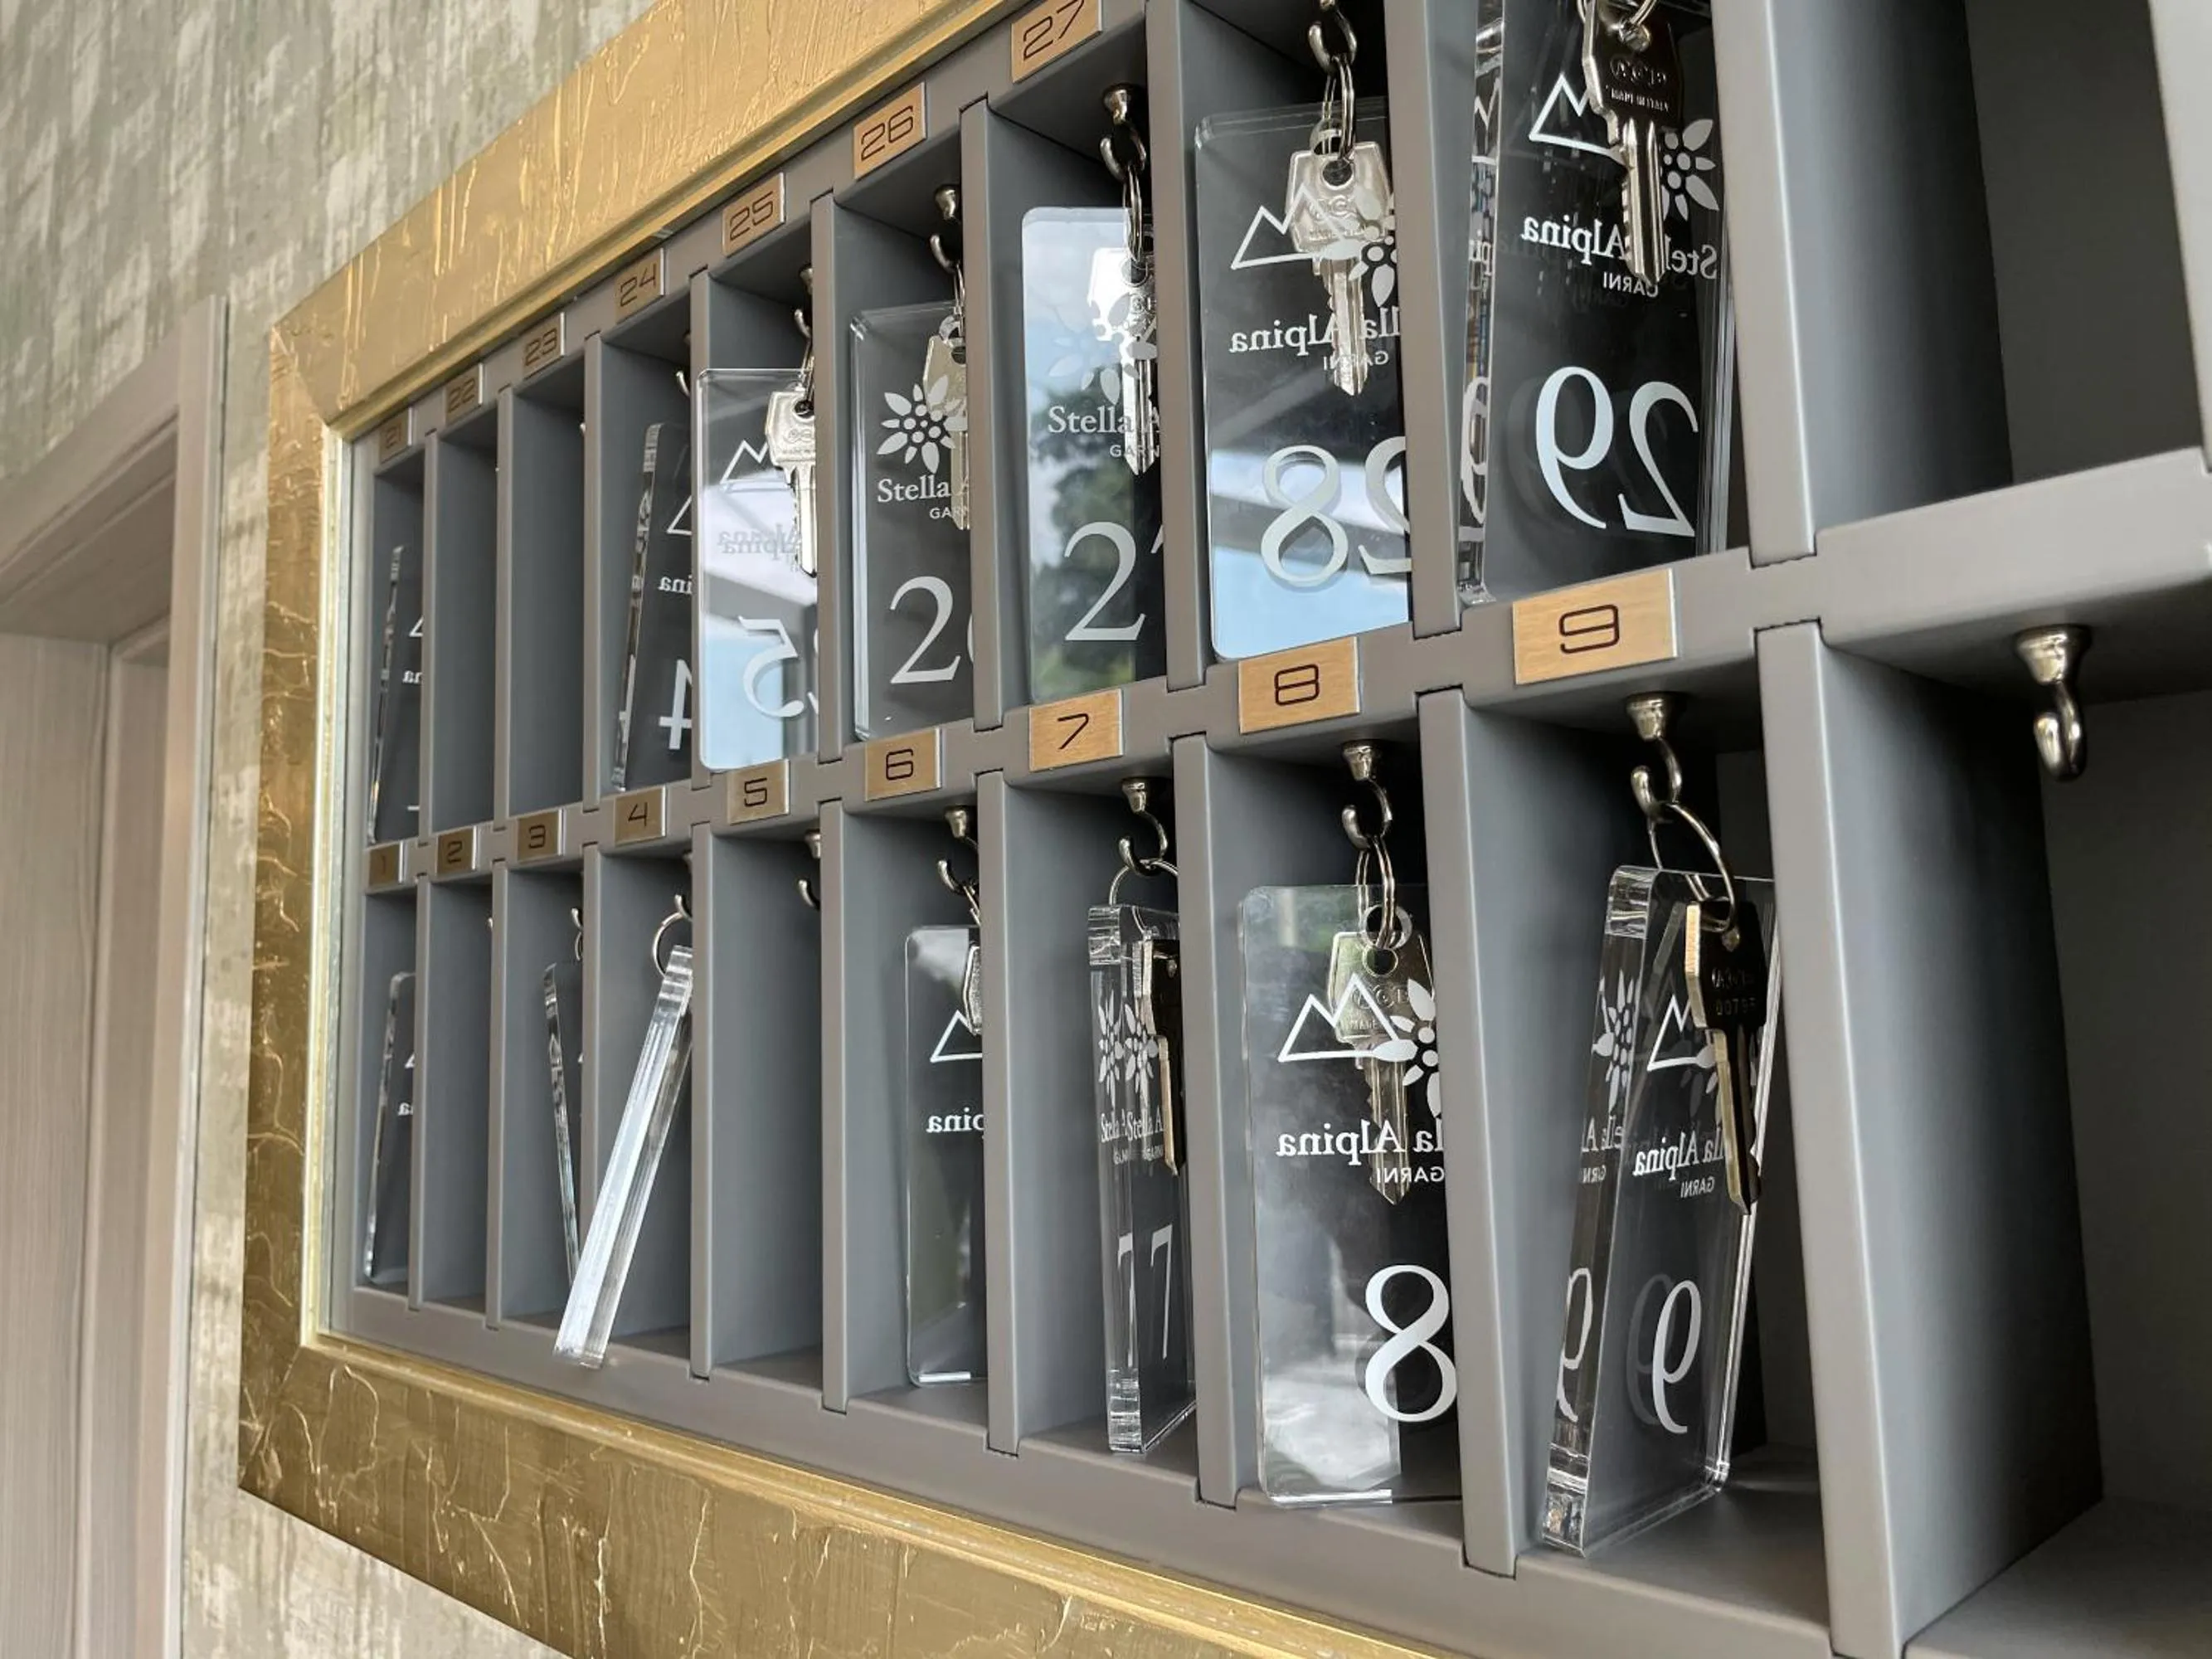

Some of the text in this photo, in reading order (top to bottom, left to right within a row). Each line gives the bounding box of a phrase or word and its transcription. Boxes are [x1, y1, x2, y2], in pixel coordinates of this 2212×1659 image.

[1022, 0, 1085, 61] 27
[860, 105, 914, 161] 26
[728, 190, 775, 241] 25
[620, 263, 657, 308] 24
[524, 327, 557, 367] 23
[448, 377, 476, 412] 22
[385, 421, 402, 450] 21
[1047, 404, 1135, 434] Stella
[877, 474, 951, 503] Stella
[1064, 520, 1164, 641] 2
[890, 575, 975, 685] 2
[1558, 603, 1621, 654] 9
[1273, 663, 1320, 706] 8
[1056, 713, 1090, 750] 7
[885, 748, 914, 781] 6
[743, 777, 768, 807] 5
[627, 800, 649, 827] 4
[447, 839, 463, 864] 2
[527, 824, 547, 849] 3
[1150, 1224, 1173, 1360] 7
